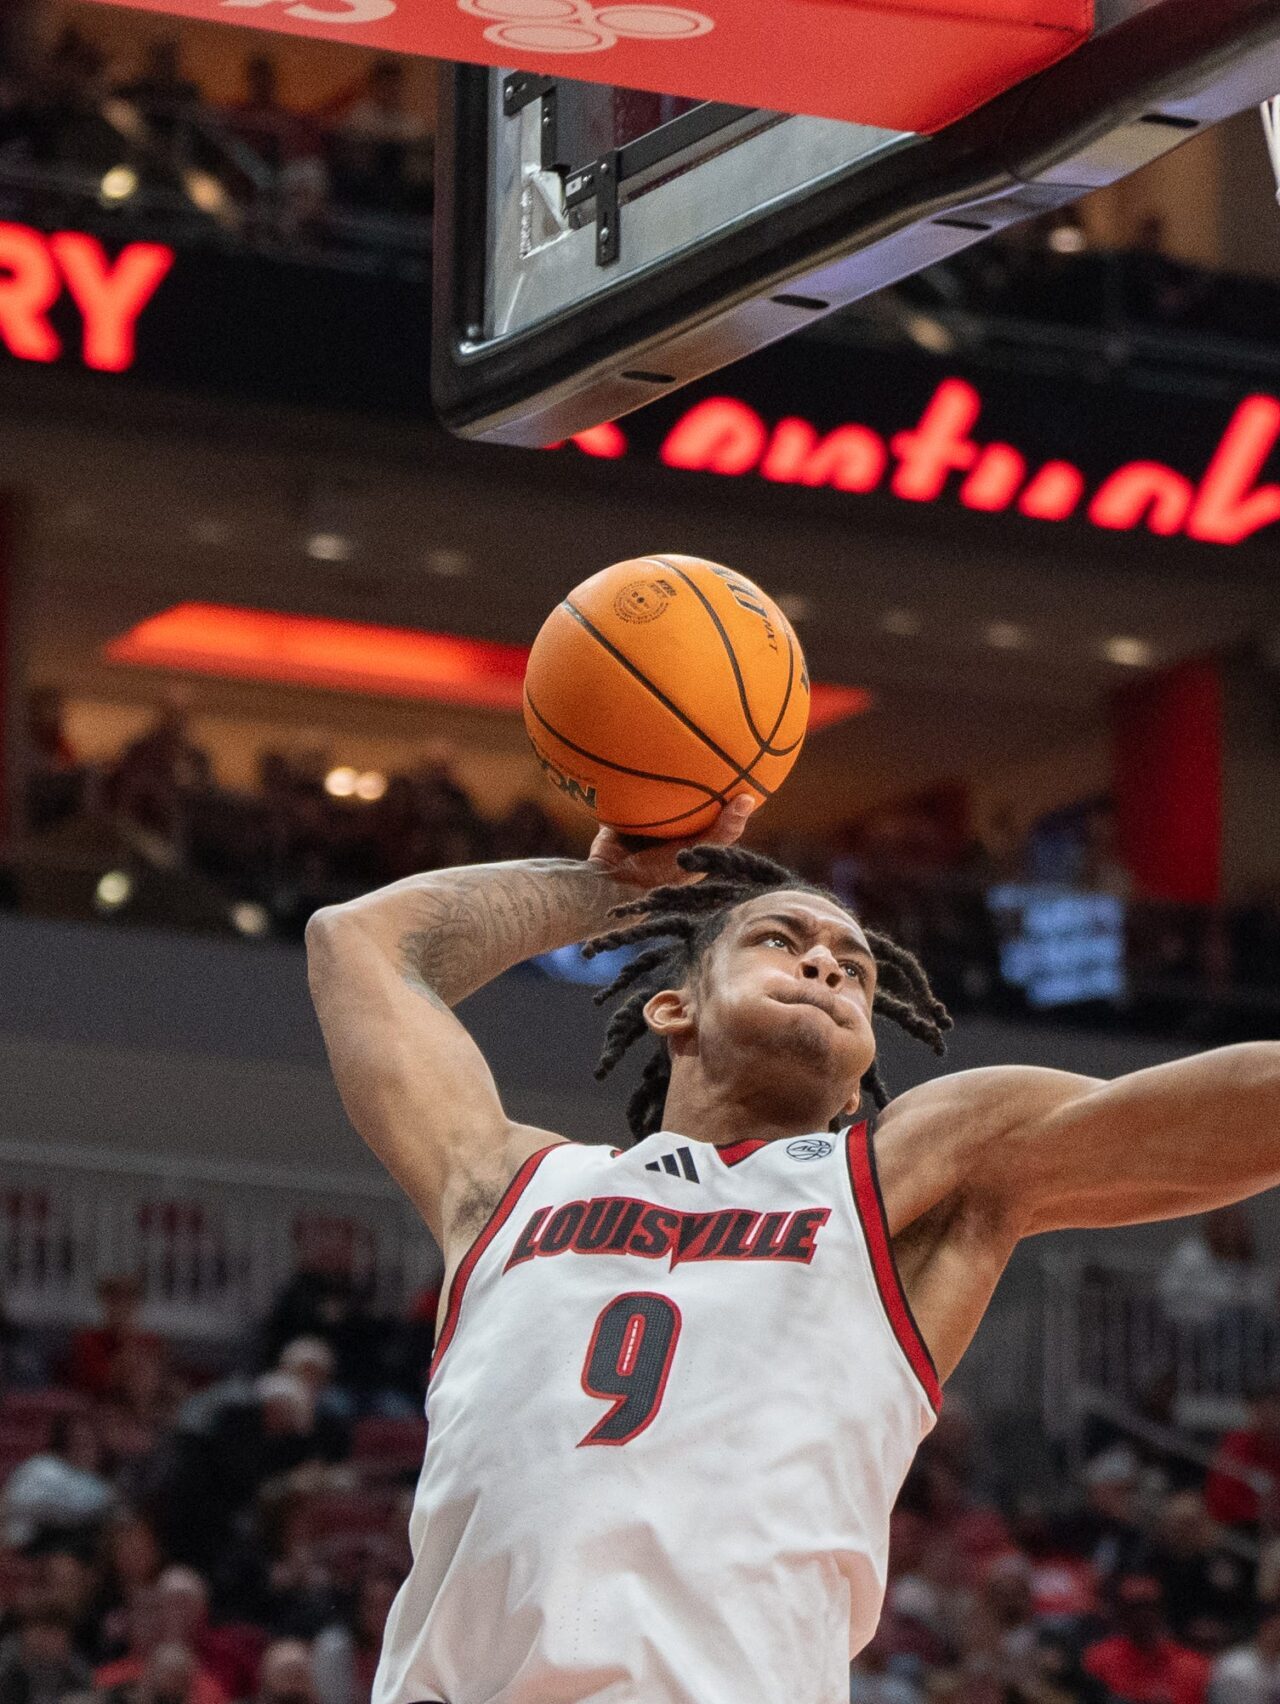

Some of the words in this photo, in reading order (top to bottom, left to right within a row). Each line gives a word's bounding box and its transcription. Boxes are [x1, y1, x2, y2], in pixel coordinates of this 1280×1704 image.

[0, 220, 175, 373] RY
[502, 1196, 832, 1277] LOUISVILLE
[576, 1291, 683, 1448] 9
